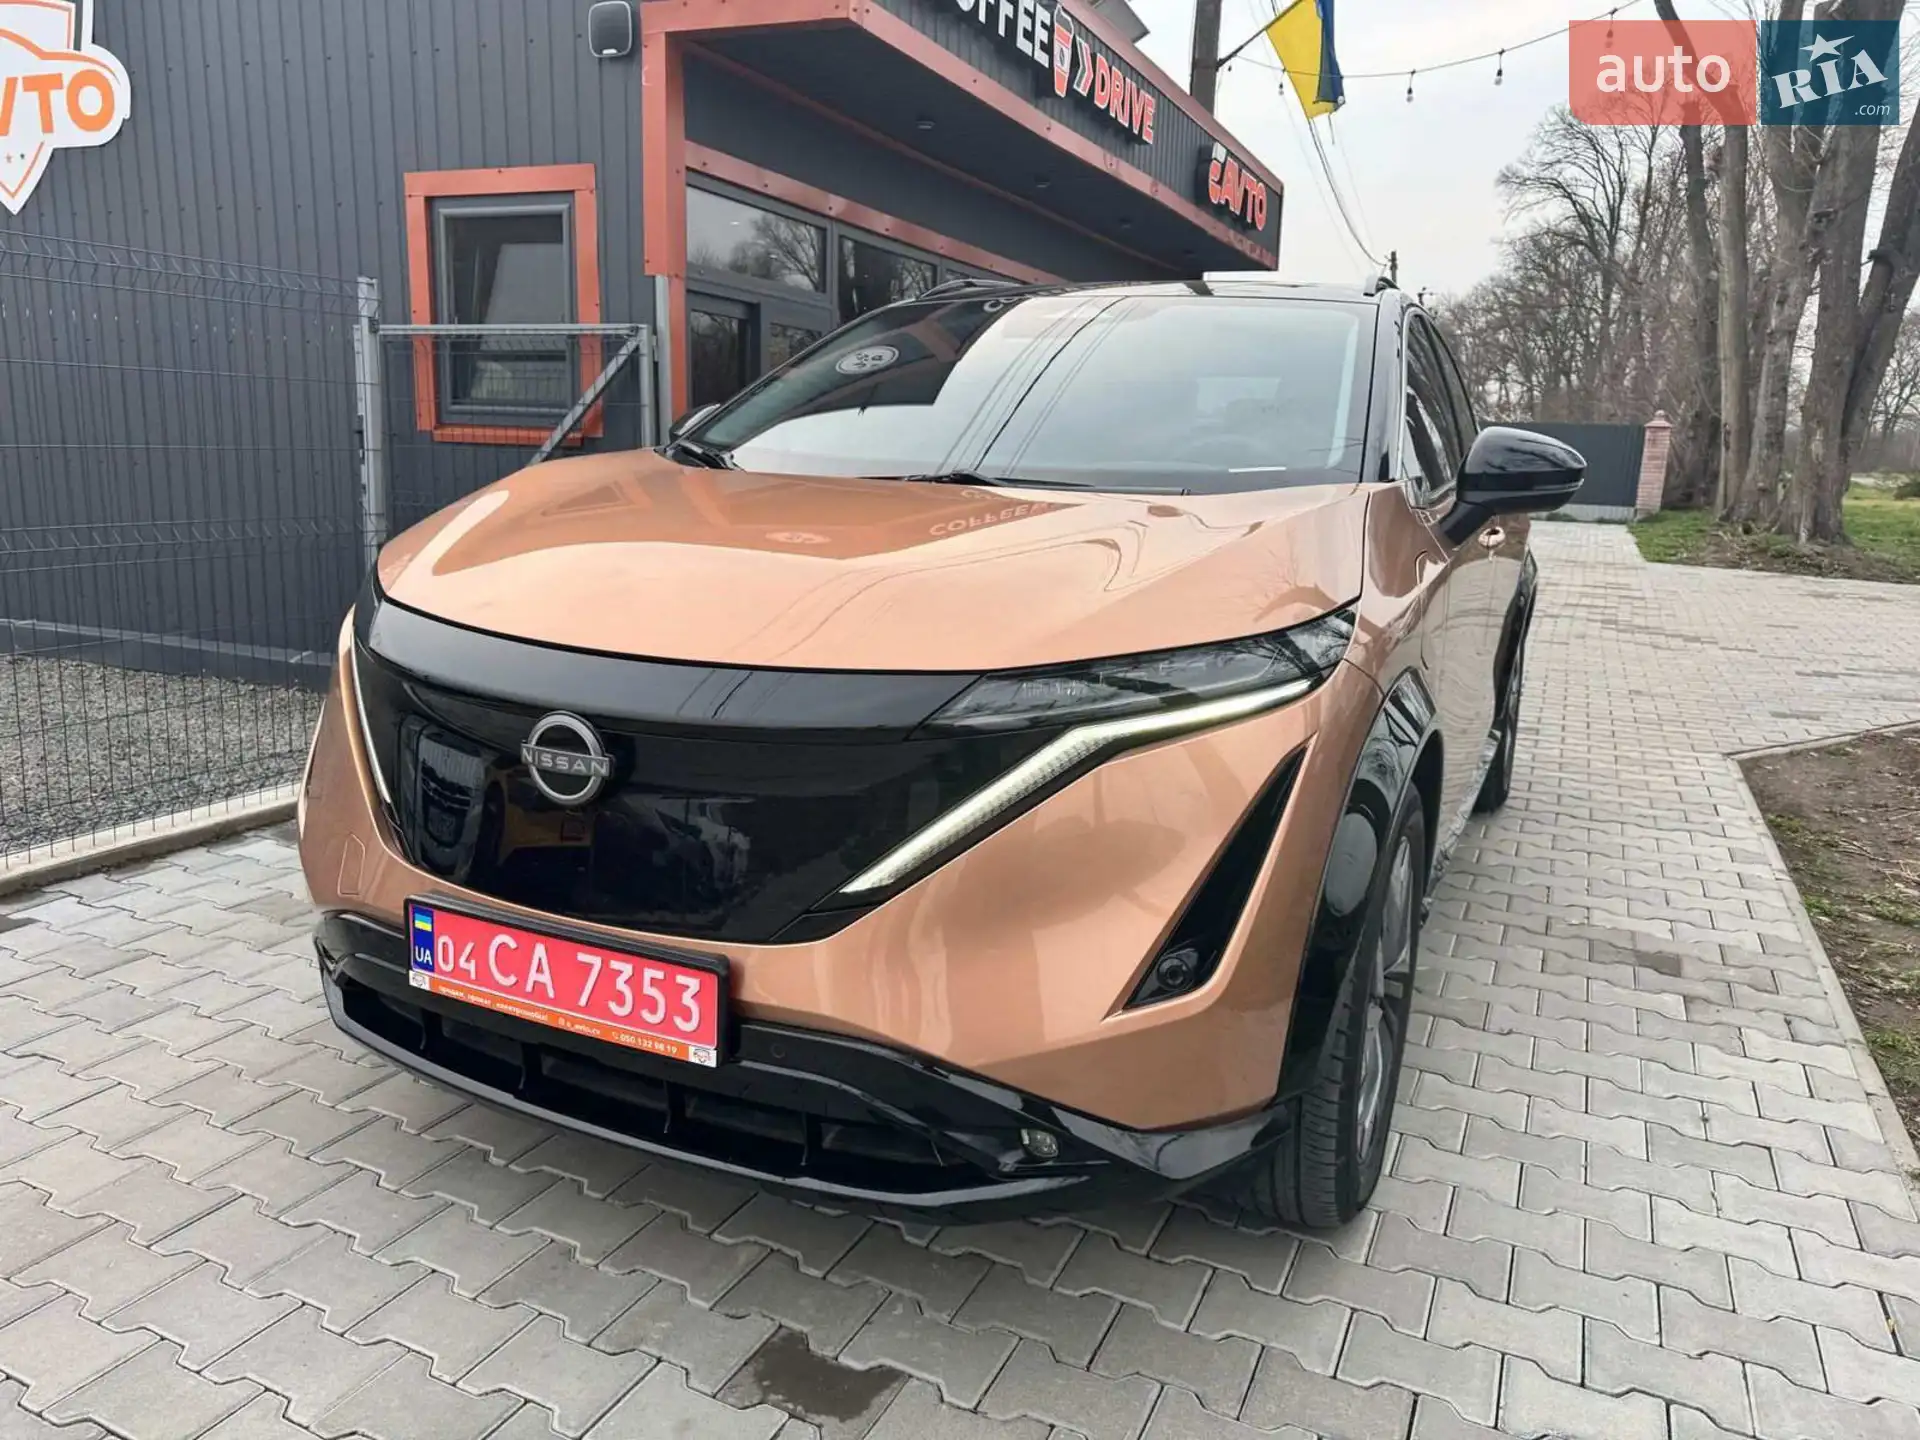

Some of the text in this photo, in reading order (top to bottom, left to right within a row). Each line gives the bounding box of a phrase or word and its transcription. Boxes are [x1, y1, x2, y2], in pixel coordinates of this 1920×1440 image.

[1094, 52, 1155, 145] DRIVE
[522, 746, 608, 776] NISSAN
[415, 947, 432, 966] UA
[437, 933, 701, 1033] 04 CA 7353
